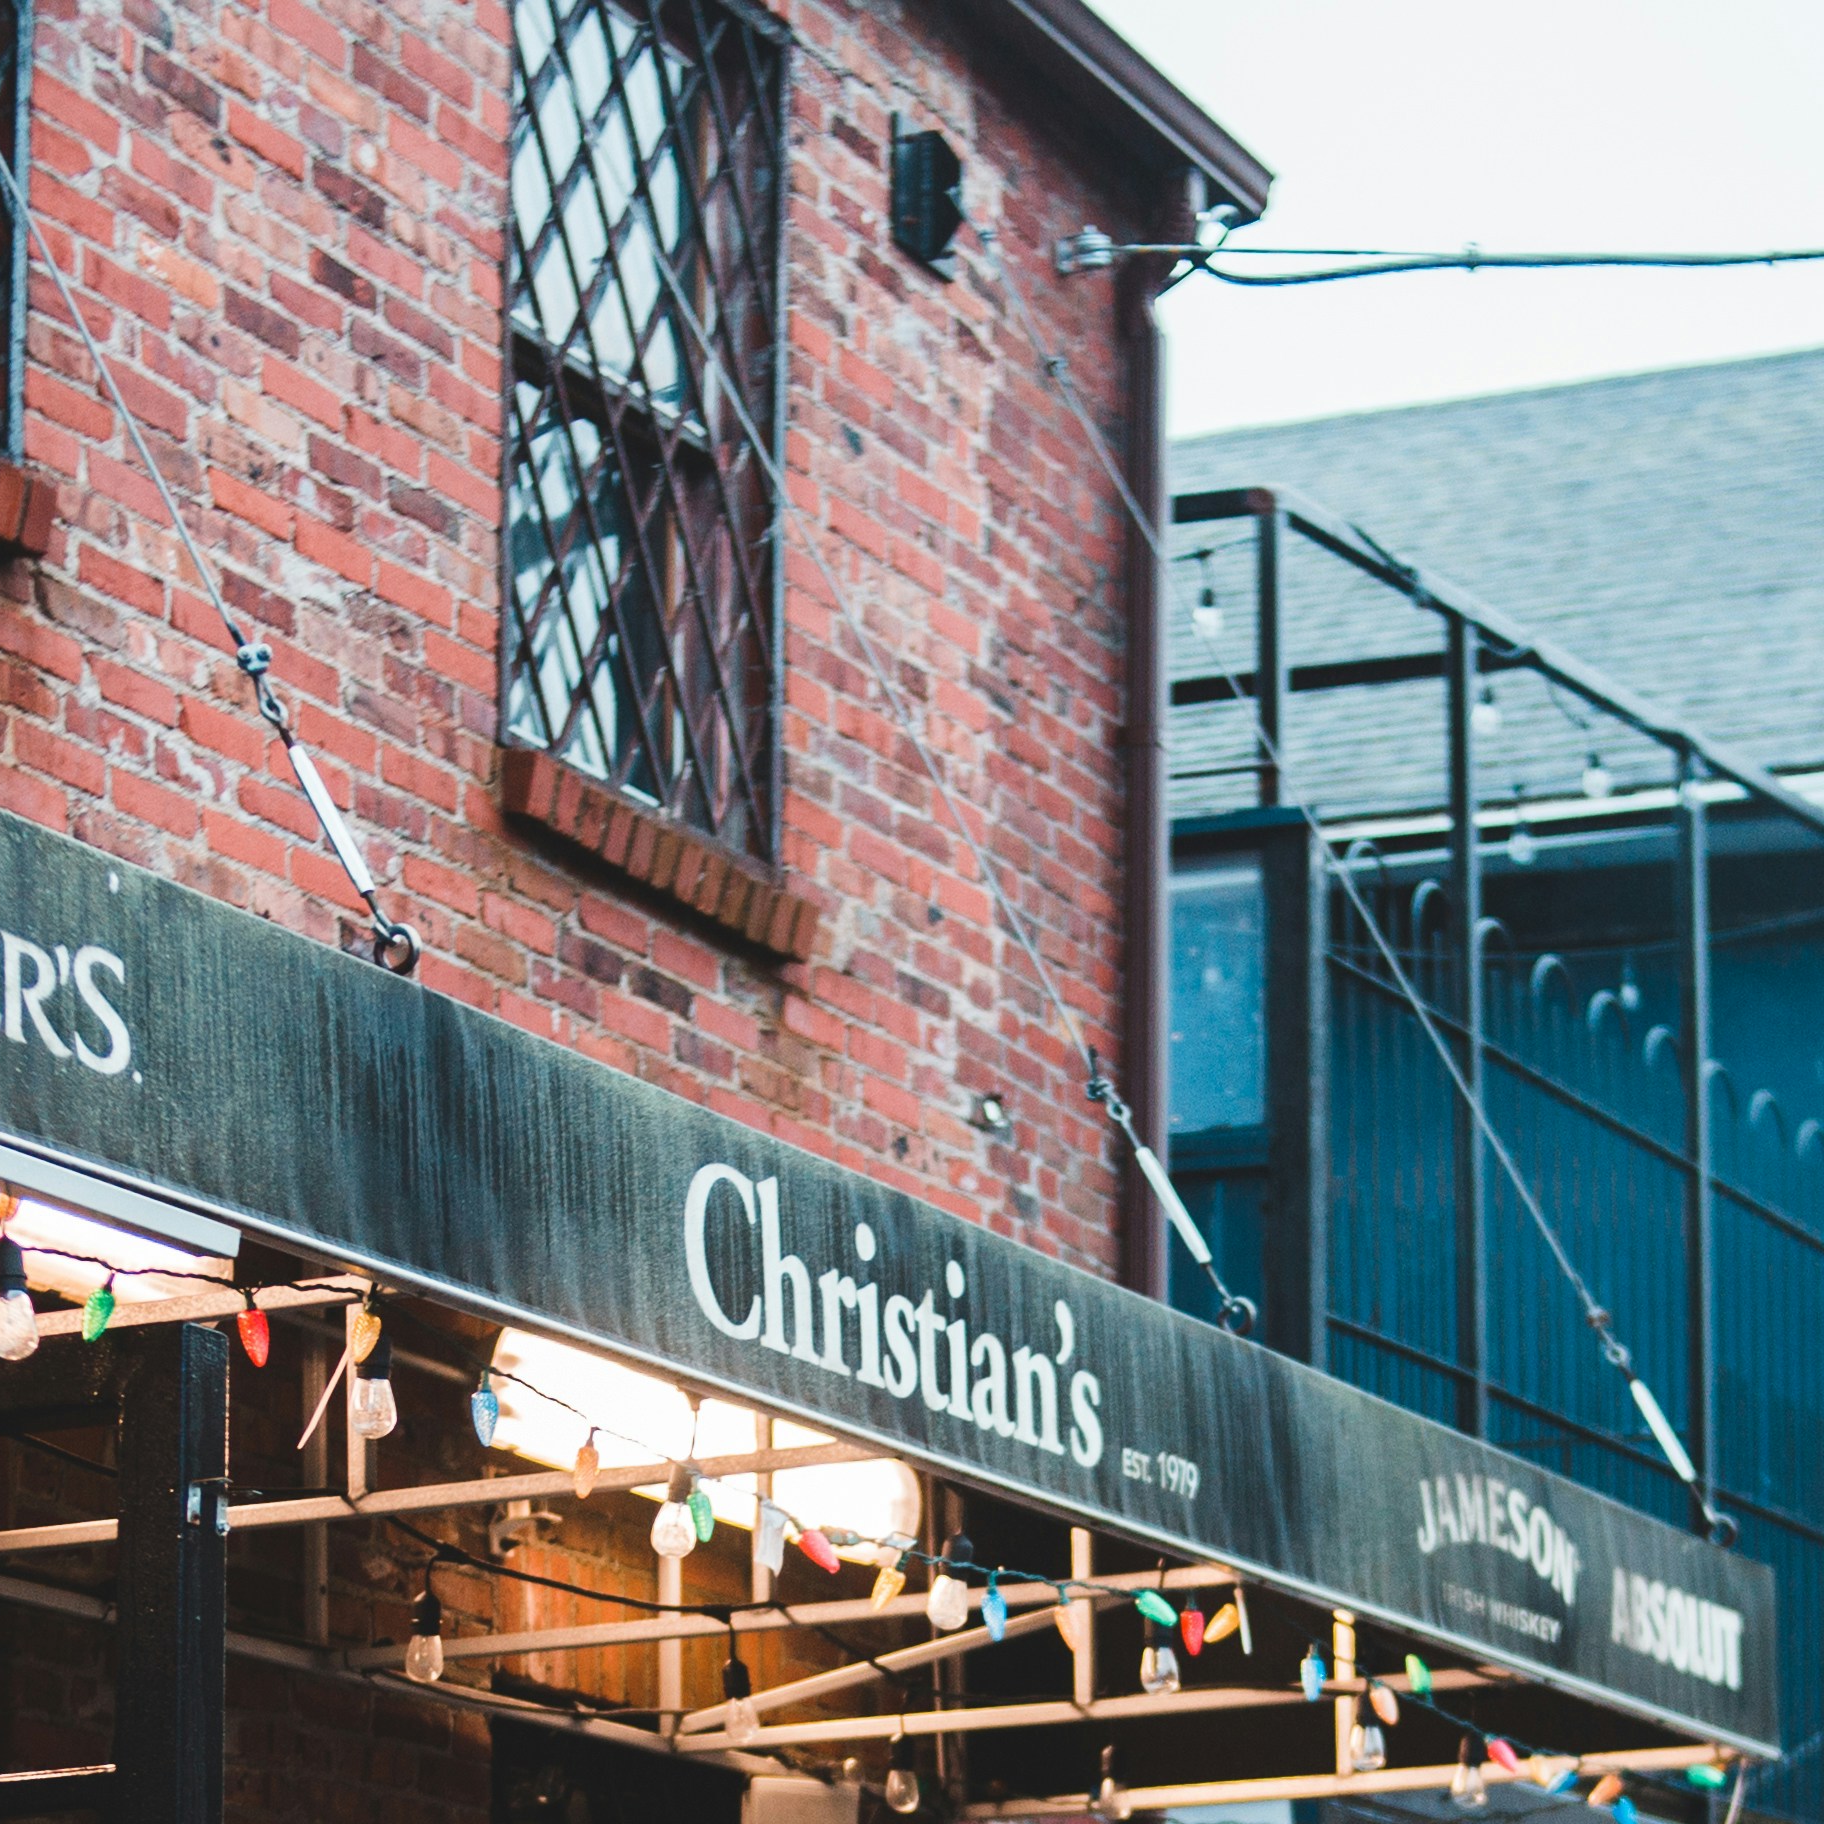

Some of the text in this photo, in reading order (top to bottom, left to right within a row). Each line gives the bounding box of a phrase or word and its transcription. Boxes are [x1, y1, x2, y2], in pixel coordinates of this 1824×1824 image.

[683, 1162, 1198, 1499] Christian's EST. 1979
[1417, 1472, 1578, 1607] JAMESON
[1442, 1582, 1562, 1644] IRISH WHISKEY
[1611, 1566, 1744, 1691] ABSOLUT
